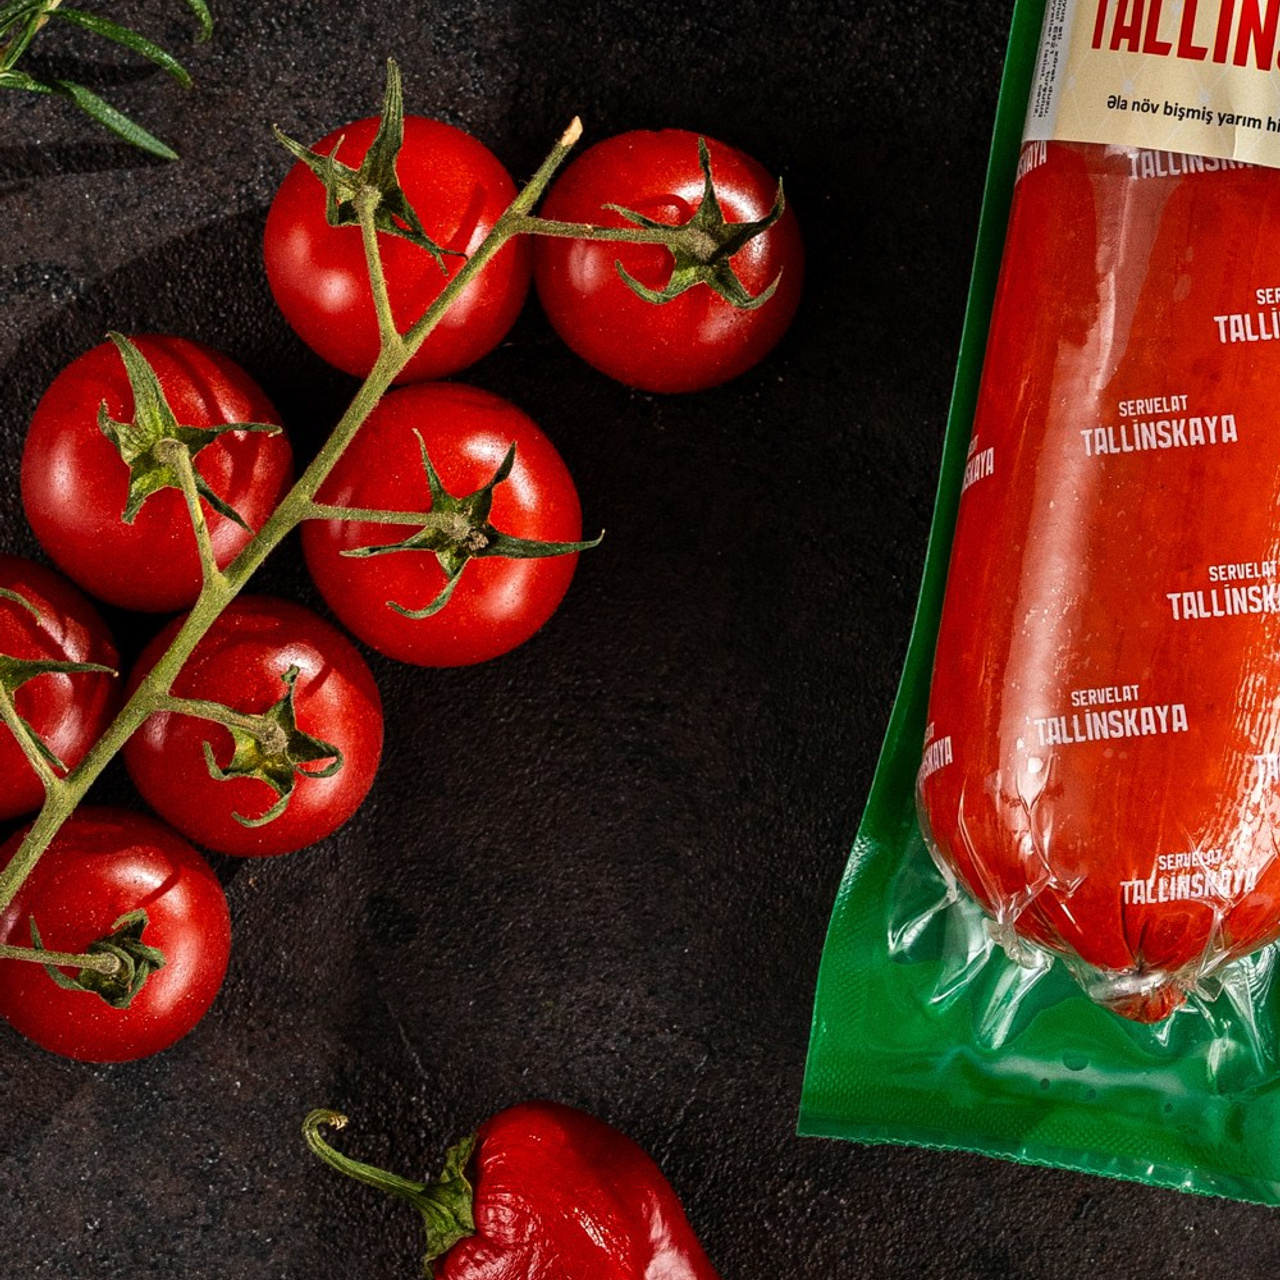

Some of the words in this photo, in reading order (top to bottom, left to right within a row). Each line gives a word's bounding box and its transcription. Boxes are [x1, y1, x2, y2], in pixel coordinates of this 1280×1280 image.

[1107, 95, 1128, 110] Əla
[1131, 99, 1159, 114] növ
[1164, 101, 1213, 124] bişmiş
[1218, 112, 1257, 129] yarım
[1119, 395, 1188, 417] SERVELAT
[1080, 414, 1238, 456] TALLİNSKAYA
[1209, 560, 1278, 582] SERVELAT
[1071, 685, 1139, 707] SERVELAT
[1034, 703, 1188, 746] TALLİNSKAYA
